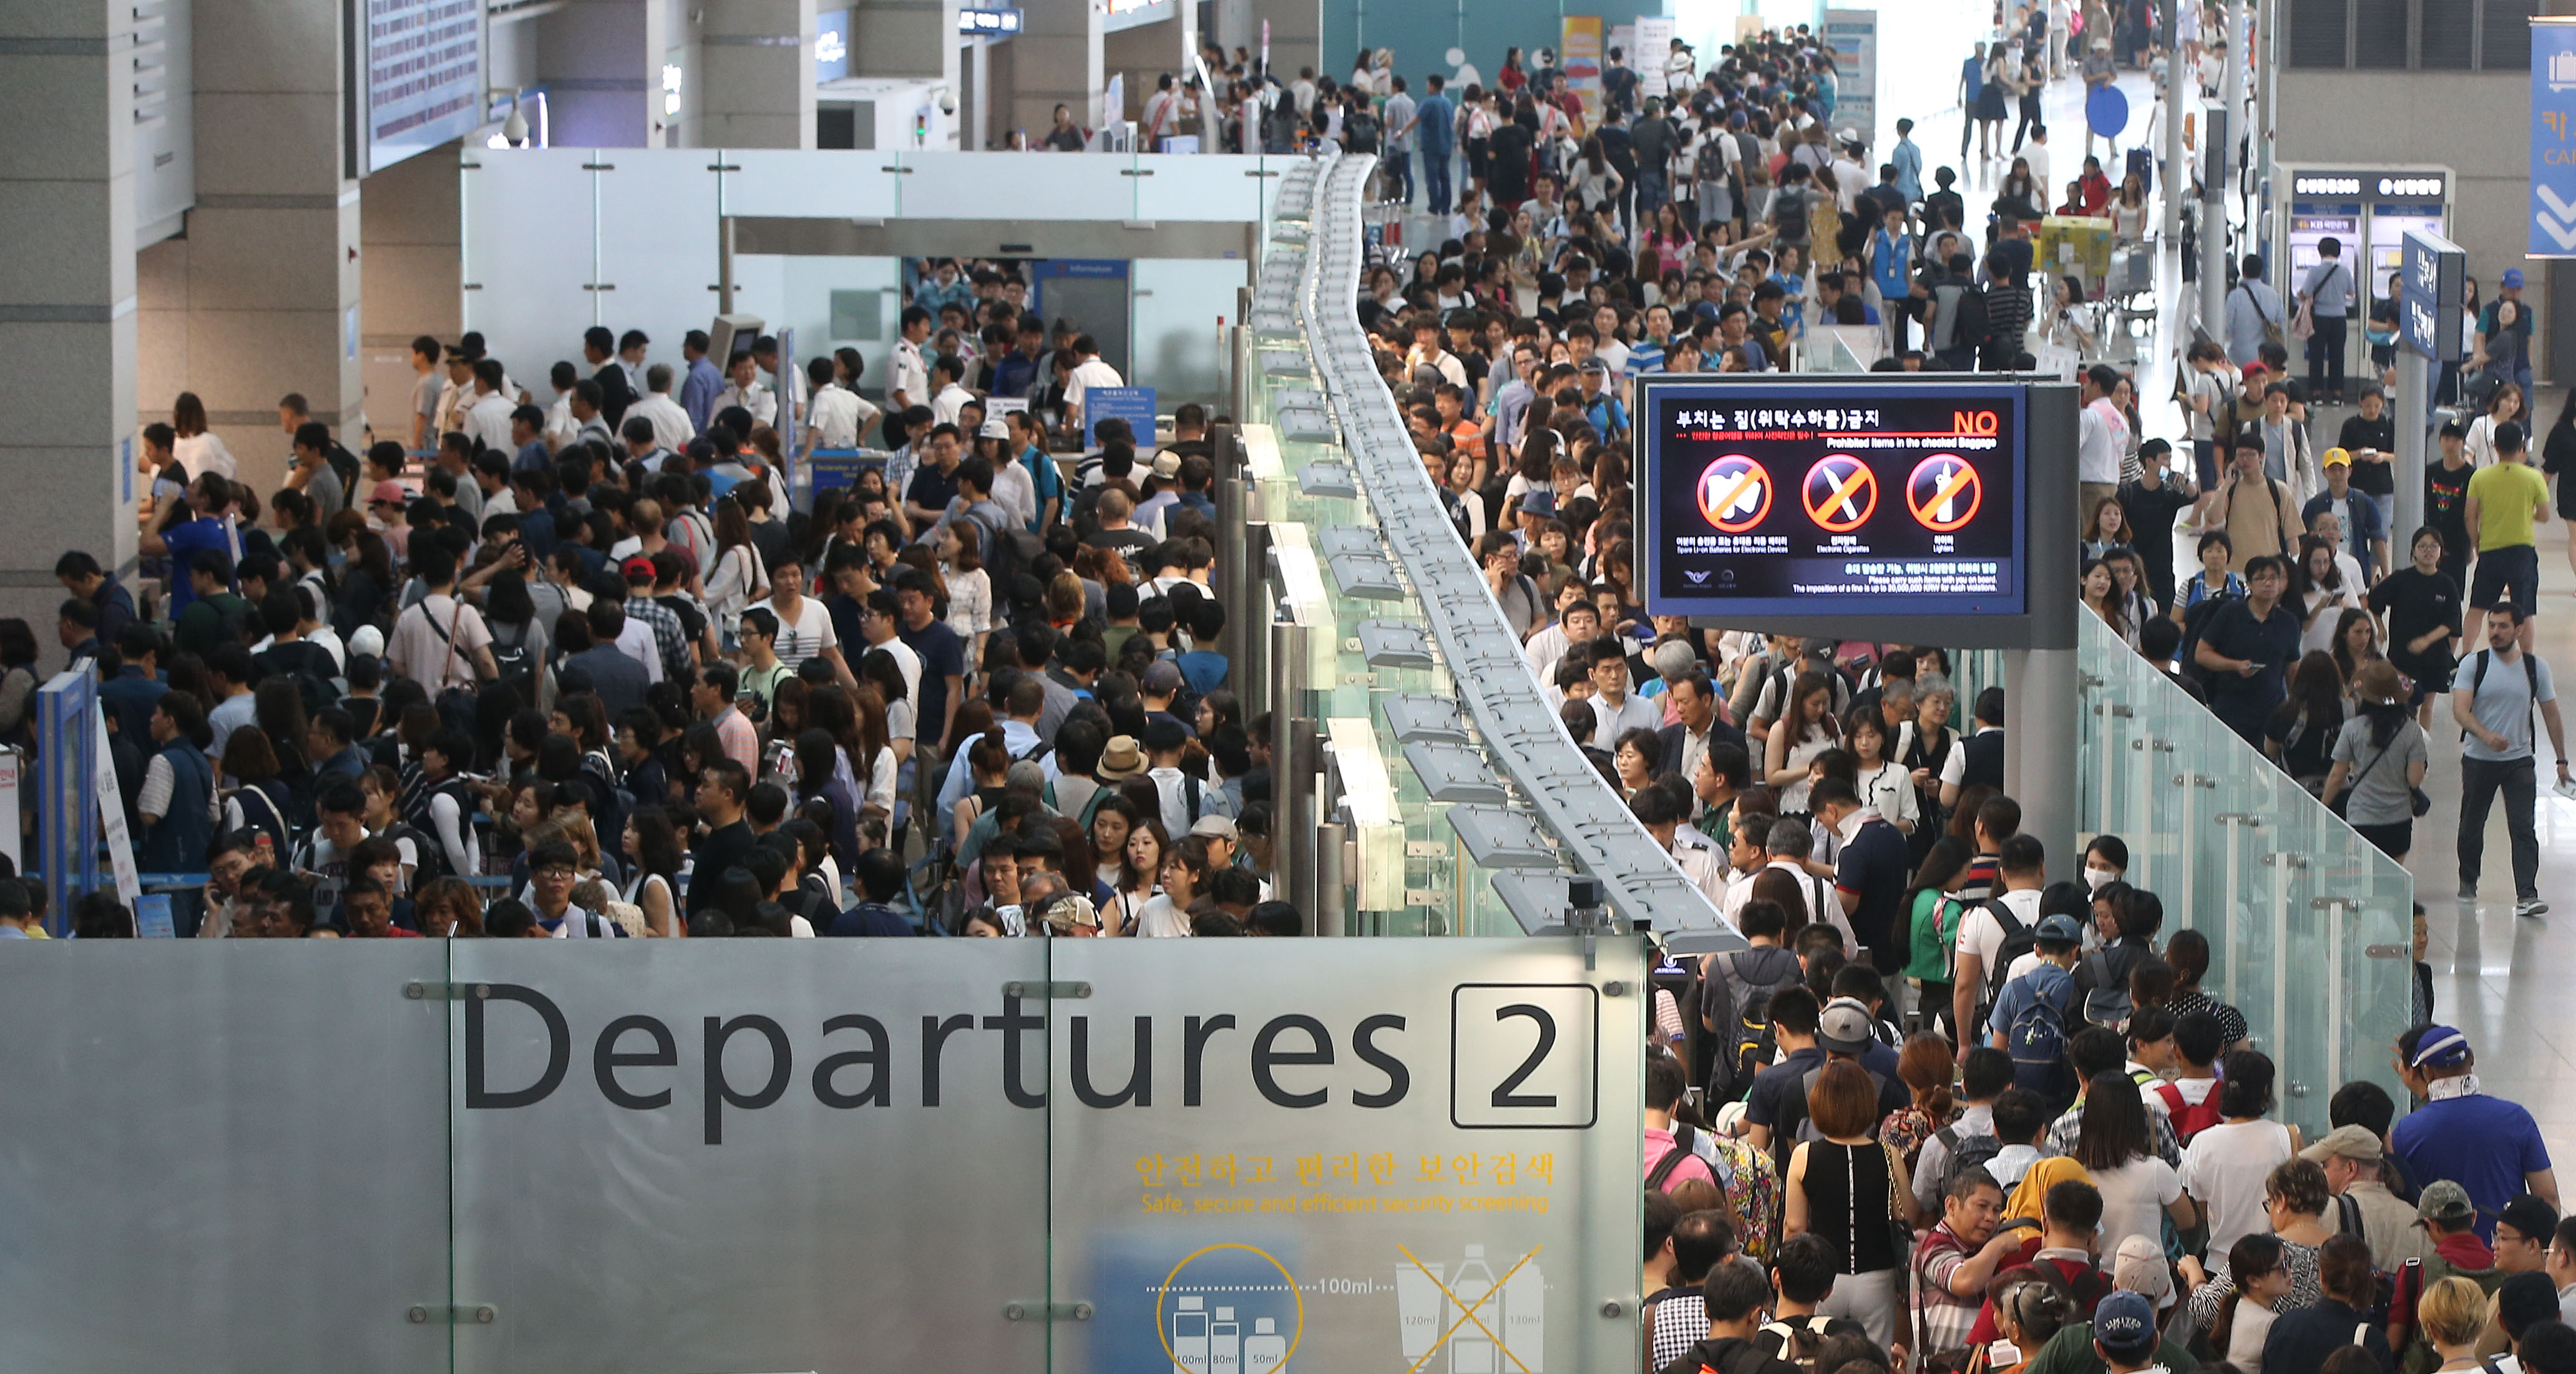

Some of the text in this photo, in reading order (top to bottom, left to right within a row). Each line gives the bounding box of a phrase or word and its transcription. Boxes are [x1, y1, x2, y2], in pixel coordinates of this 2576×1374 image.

[2542, 111, 2576, 142] 카
[1676, 409, 1726, 431] 부치는
[1954, 411, 1997, 435] NO
[1827, 437, 1870, 449] Prohibited
[1906, 437, 1920, 448] the
[1921, 437, 1956, 448] checked
[1958, 437, 1997, 450] Baggage
[1868, 575, 1890, 584] Please
[1891, 576, 1906, 585] carry
[1908, 576, 1923, 584] such
[1942, 576, 1954, 584] with
[1956, 576, 1967, 585] you
[1793, 585, 1805, 593] The
[1838, 584, 1845, 593] of
[1852, 584, 1863, 593] fine
[1871, 585, 1879, 593] up
[1880, 585, 1886, 593] to
[1941, 584, 1949, 592] for
[1950, 584, 1966, 592] each
[466, 983, 1557, 1144] Departures 2
[1136, 1152, 1553, 1187] 안전하고 편리한 보안검색
[1141, 1191, 1548, 1214] Safe, secure and efficient security screening
[1319, 1278, 1372, 1295] 100ml
[1406, 1315, 1435, 1325] 120ml
[1177, 1354, 1207, 1365] 100ml
[1212, 1354, 1237, 1365] 80ml
[1253, 1353, 1279, 1364] 50ml
